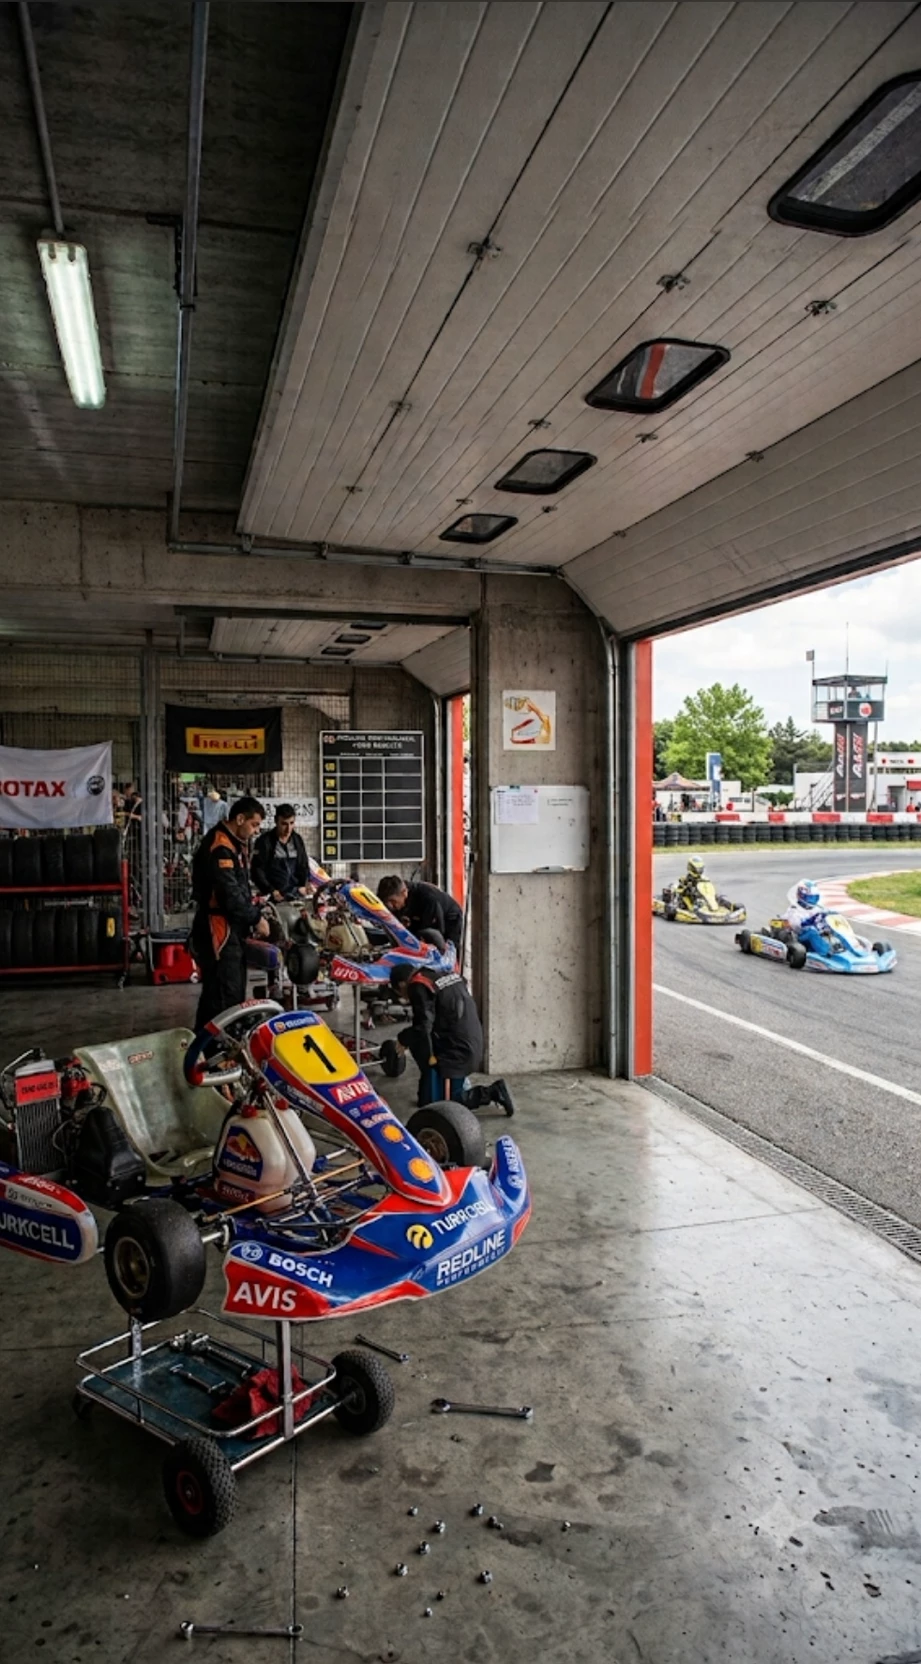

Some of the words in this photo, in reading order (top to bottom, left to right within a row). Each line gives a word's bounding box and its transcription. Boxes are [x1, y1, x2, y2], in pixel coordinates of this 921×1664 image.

[0, 780, 66, 797] OTAX
[303, 1034, 337, 1073] 1
[269, 1252, 334, 1288] BOSCH
[436, 1229, 506, 1280] REDLINE
[233, 1281, 298, 1312] AVIS
